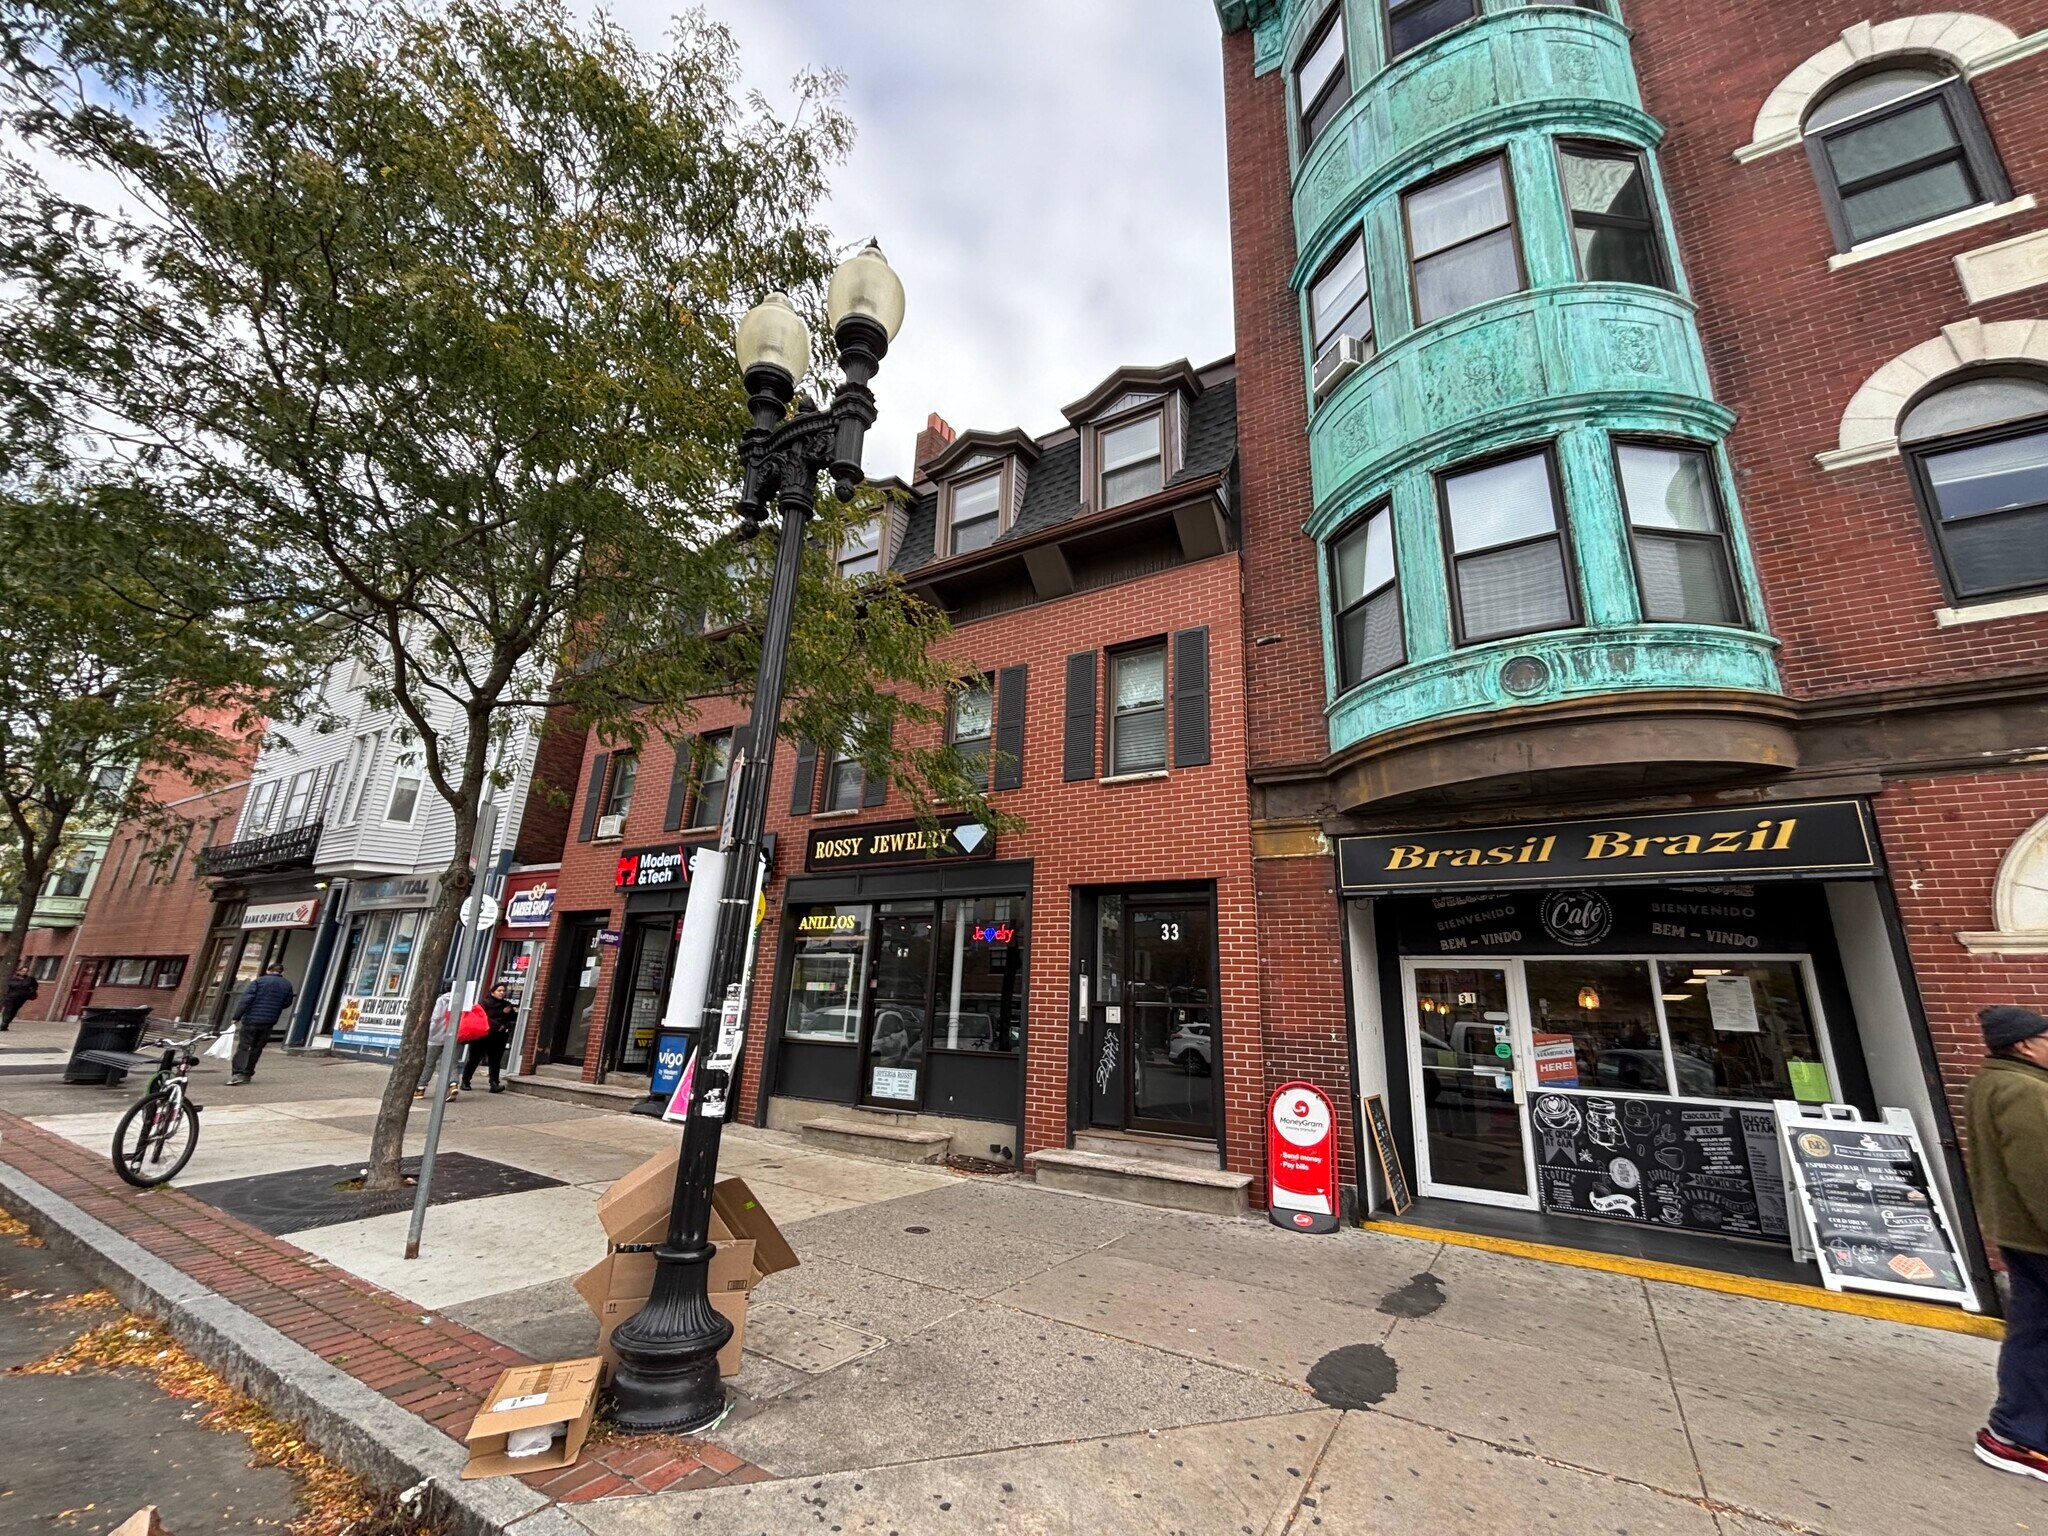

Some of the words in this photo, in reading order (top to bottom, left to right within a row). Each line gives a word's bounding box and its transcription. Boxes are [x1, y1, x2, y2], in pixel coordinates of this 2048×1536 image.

[814, 837, 863, 859] ROSSY
[1384, 835, 1557, 871] Brasil
[1582, 818, 1797, 860] Brazil
[640, 852, 681, 869] Modern
[638, 869, 672, 885] &Tech
[244, 913, 259, 924] BANK
[259, 913, 266, 924] OF
[266, 911, 294, 923] AMERICA
[1436, 905, 1516, 931] BIENVENIDO
[1551, 900, 1603, 928] Café
[1651, 902, 1756, 918] BIENVENIDO
[799, 915, 855, 930] ANILLOS
[1161, 923, 1179, 941] 33
[1652, 922, 1686, 938] BEM
[1706, 929, 1759, 948] VINDO
[1439, 936, 1468, 951] BEM
[1480, 930, 1522, 945] VINDO
[363, 998, 377, 1013] NEW
[376, 999, 402, 1015] PATIENT
[1459, 993, 1475, 1004] 31
[359, 1017, 383, 1025] CLEANING
[386, 1018, 402, 1026] EXAM
[659, 1048, 683, 1068] vigo
[1539, 1061, 1573, 1073] HERE!
[1280, 1116, 1323, 1129] MoneyGram
[1682, 1112, 1721, 1120] CHOCOLATE
[1742, 1115, 1771, 1125] SUCOS
[1744, 1122, 1776, 1134] VITAM
[1282, 1152, 1299, 1161] Send
[1300, 1154, 1322, 1164] money
[1282, 1161, 1294, 1170] Pay
[1295, 1162, 1309, 1171] bills
